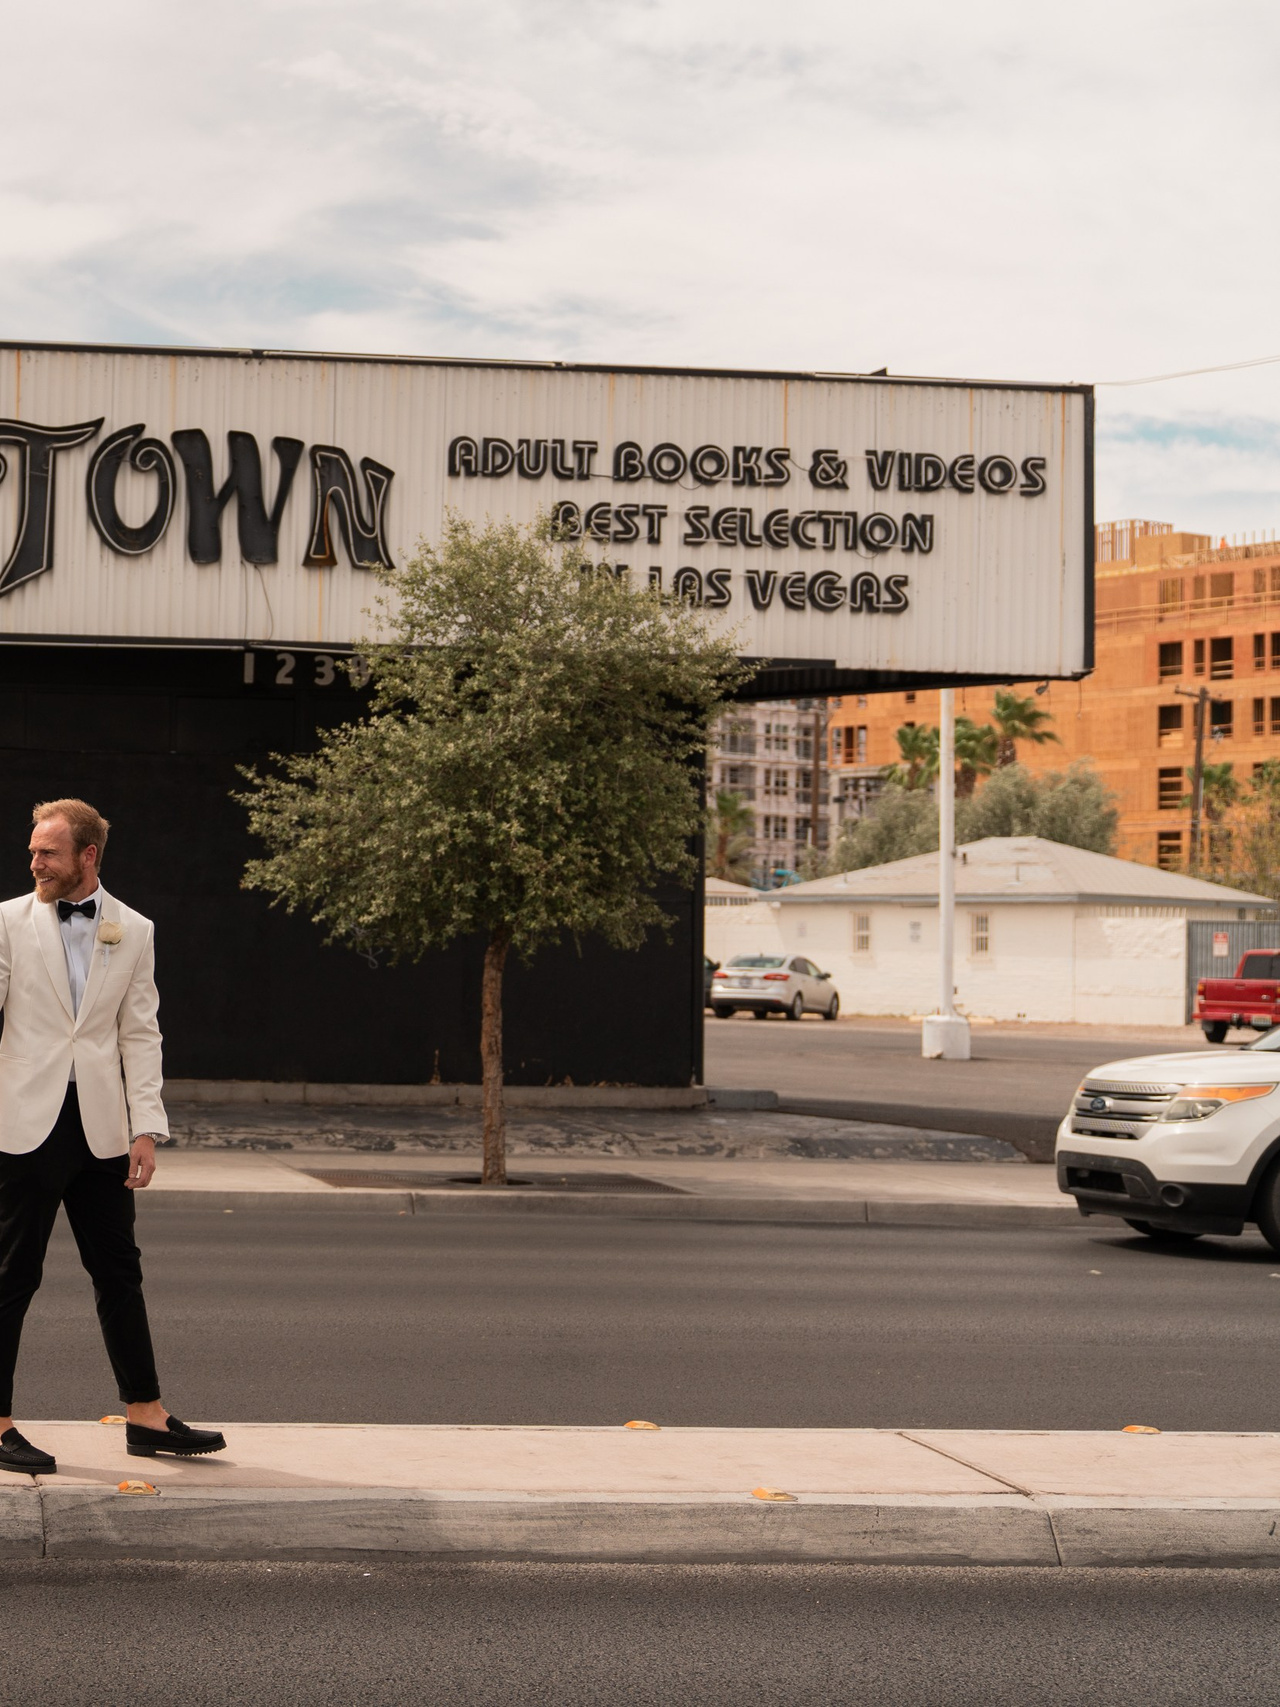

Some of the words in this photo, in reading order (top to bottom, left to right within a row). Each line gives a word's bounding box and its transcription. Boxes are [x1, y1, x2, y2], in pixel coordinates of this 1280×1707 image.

[448, 436, 598, 480] ADULT
[614, 441, 791, 486] BOOKS
[809, 449, 849, 490] &
[865, 449, 1047, 497] VIDEOS
[552, 501, 668, 544] BEST
[683, 505, 934, 553] SELECTION
[745, 570, 909, 614] VEGAS
